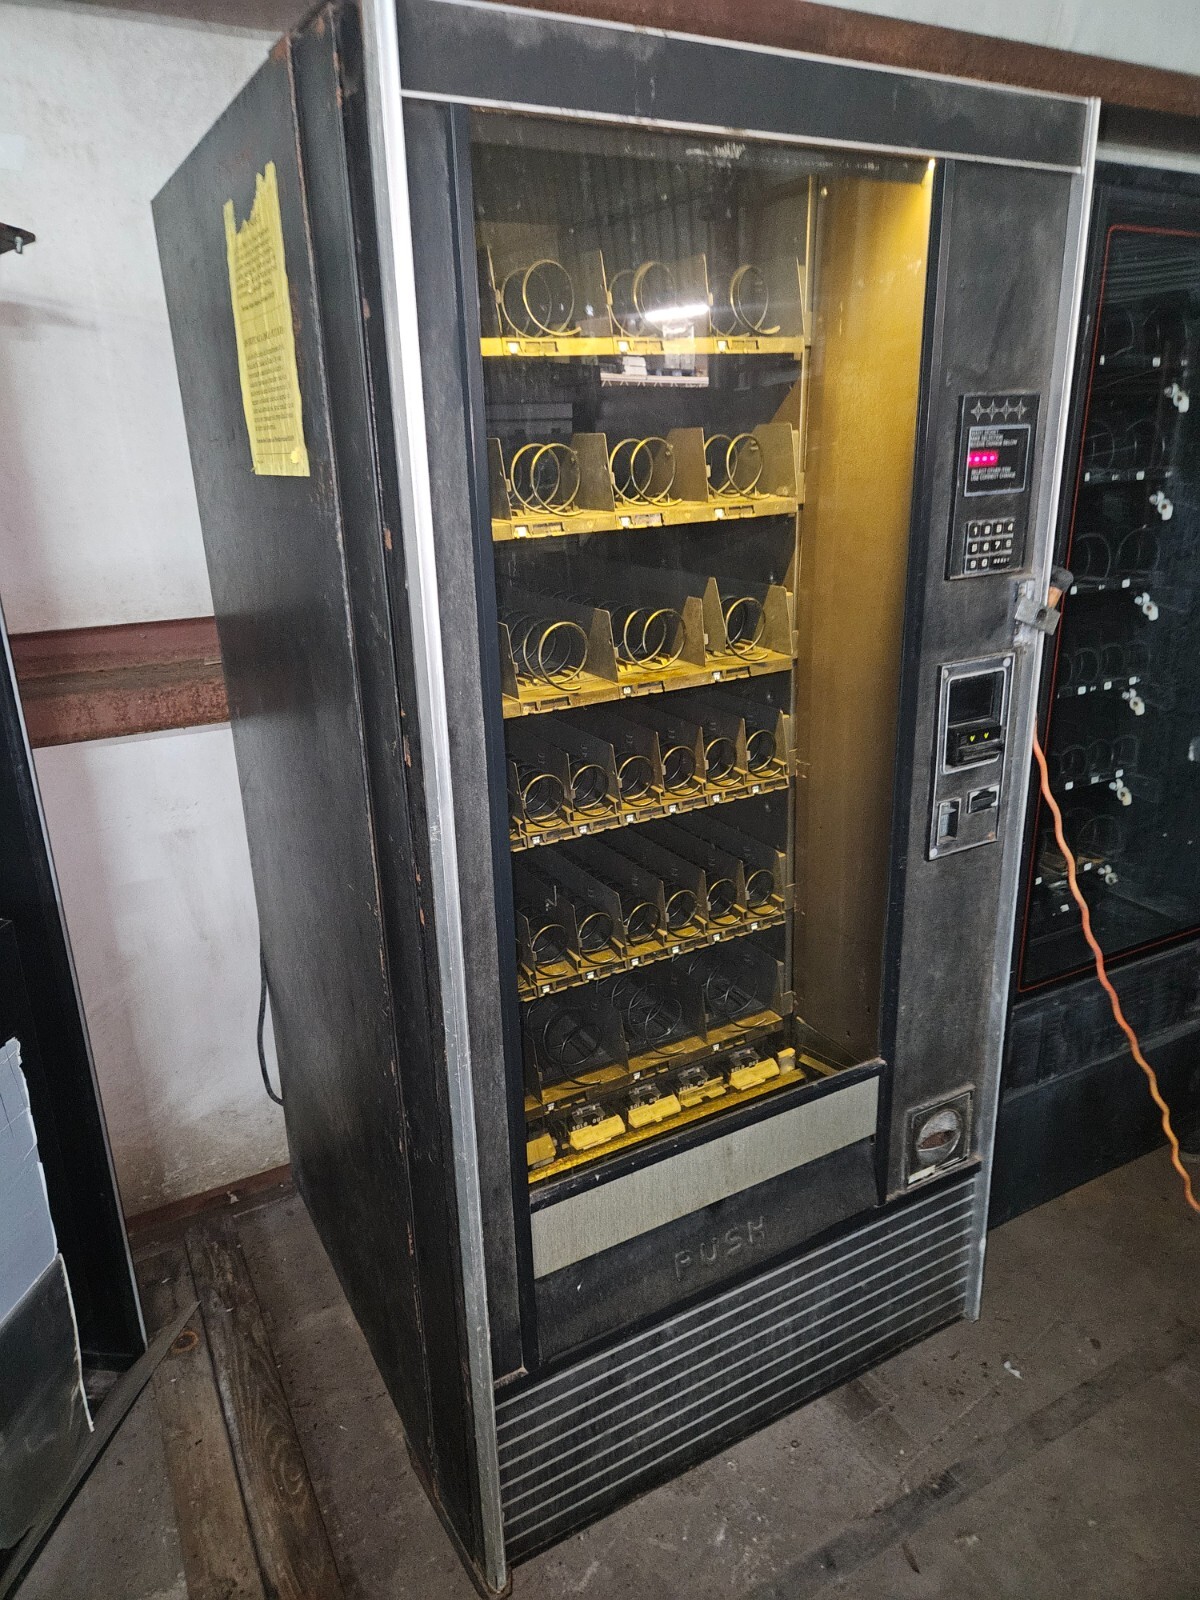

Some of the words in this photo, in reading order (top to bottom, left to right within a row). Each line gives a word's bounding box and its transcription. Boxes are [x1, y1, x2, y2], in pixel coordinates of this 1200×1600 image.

[572, 1121, 588, 1131] SOLD
[592, 1115, 604, 1124] OUT
[674, 1215, 766, 1281] PUSH
